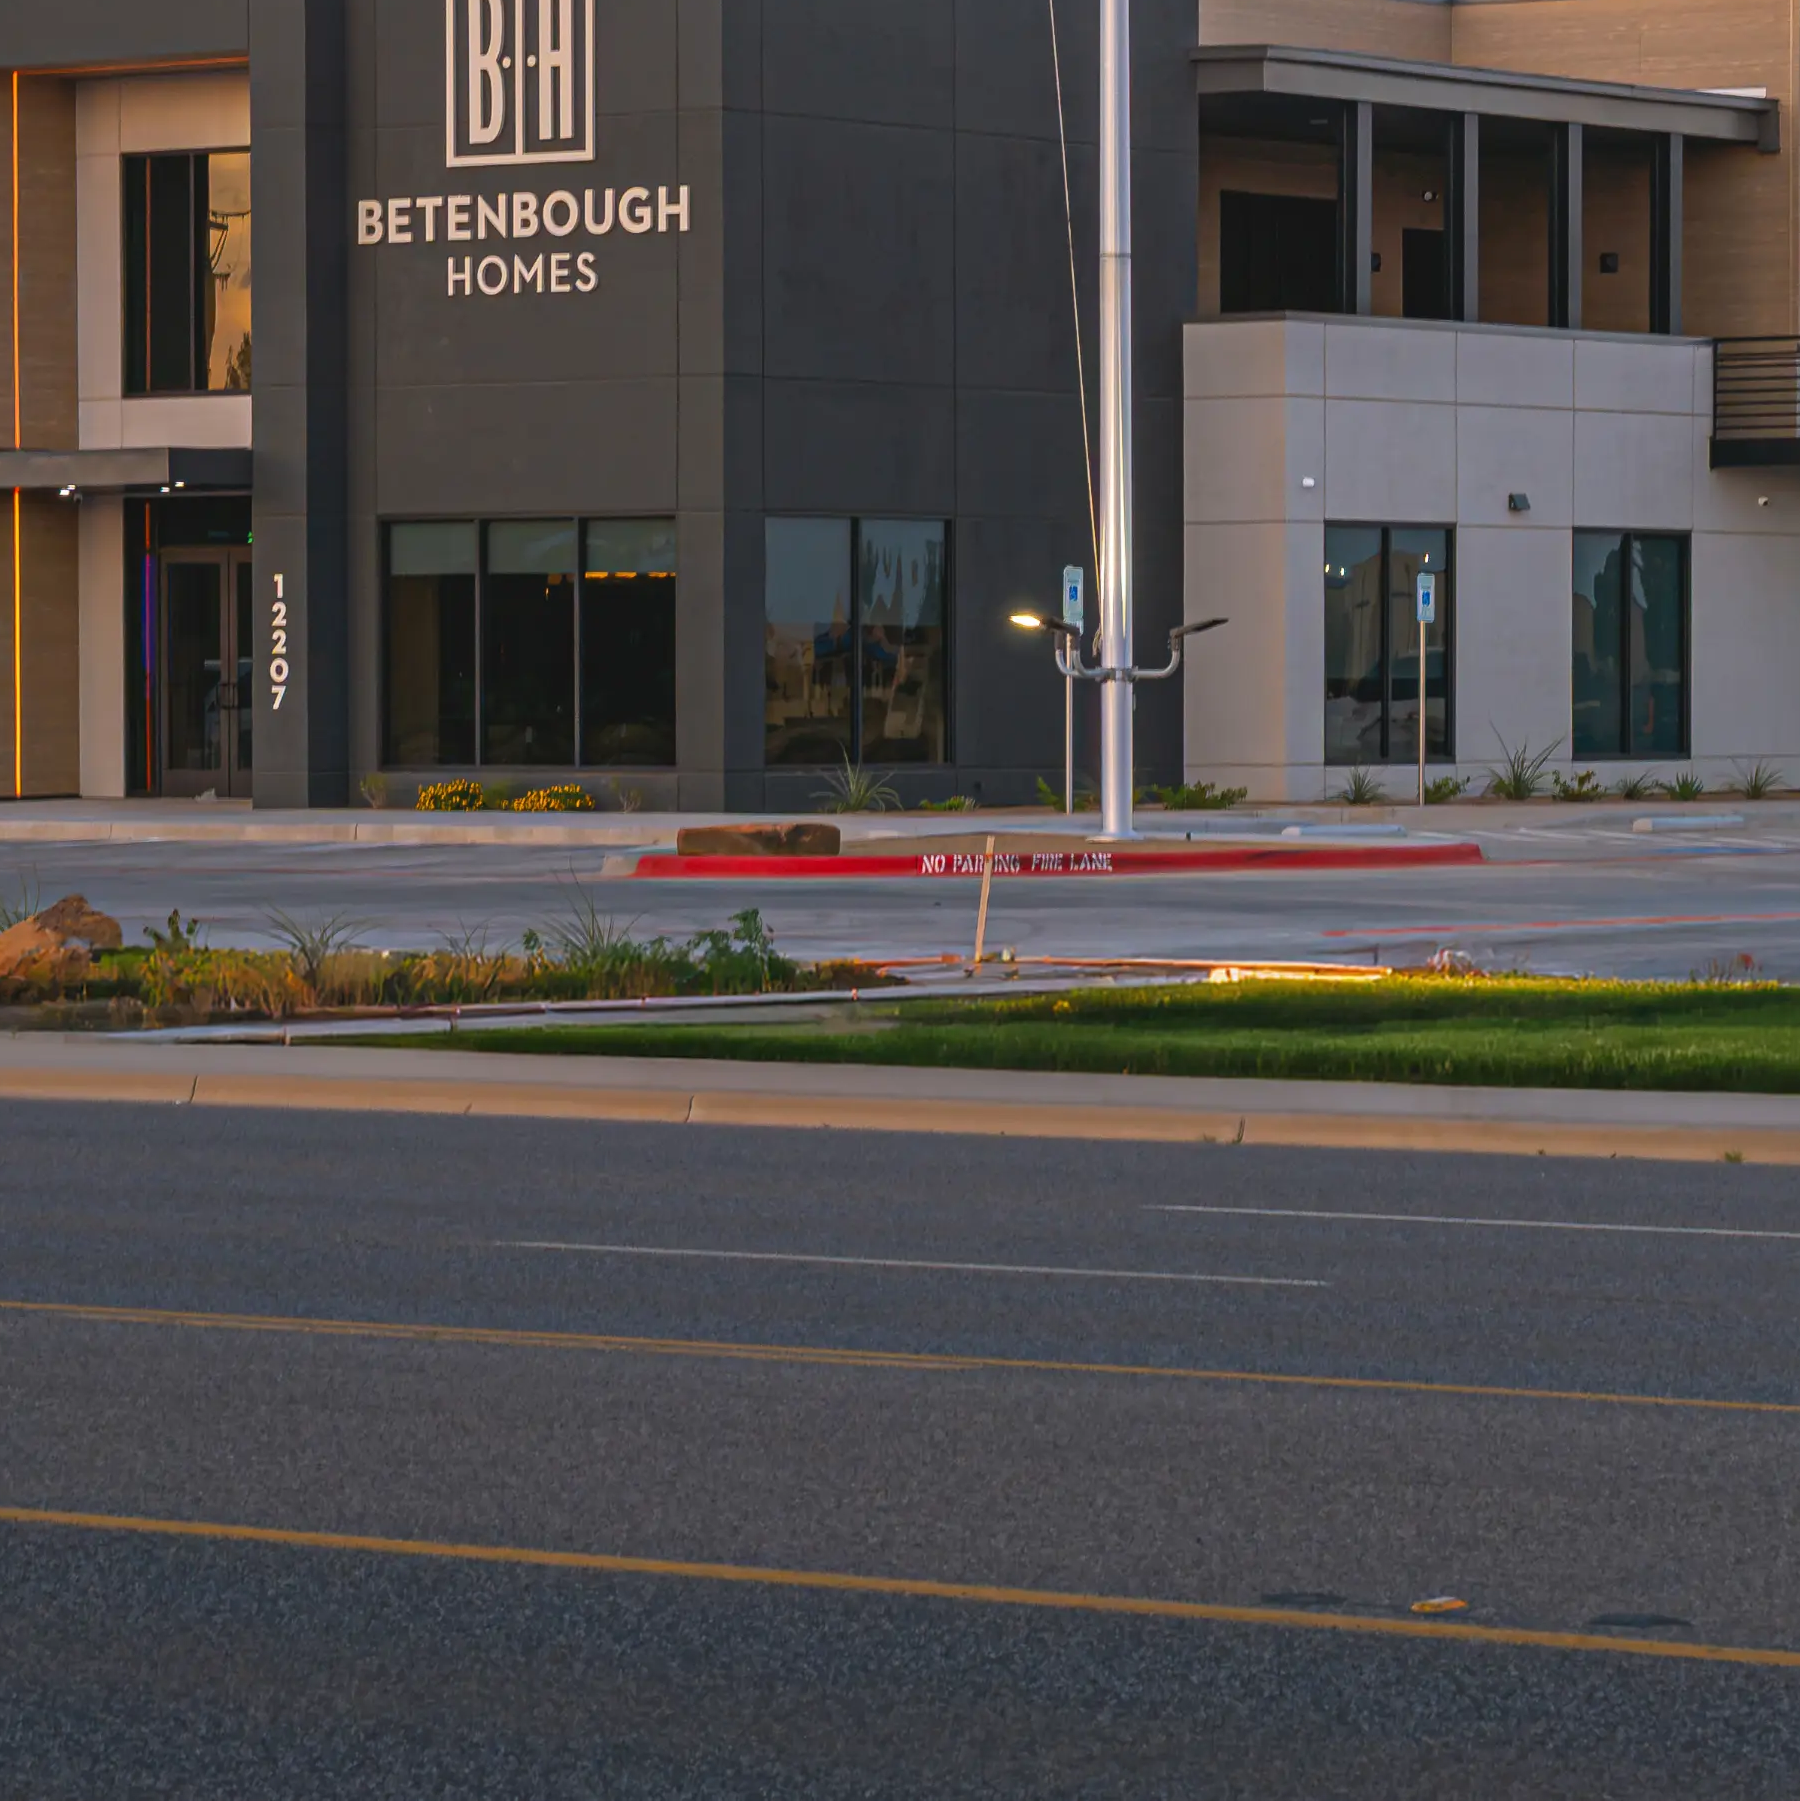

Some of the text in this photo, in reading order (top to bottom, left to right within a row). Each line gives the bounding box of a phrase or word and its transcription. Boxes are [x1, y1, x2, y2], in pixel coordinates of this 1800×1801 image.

[357, 184, 690, 245] BETENBOUGH
[446, 252, 598, 296] HOMES
[270, 574, 289, 710] 12207
[921, 852, 1113, 874] NO PARING FIRE LANE
